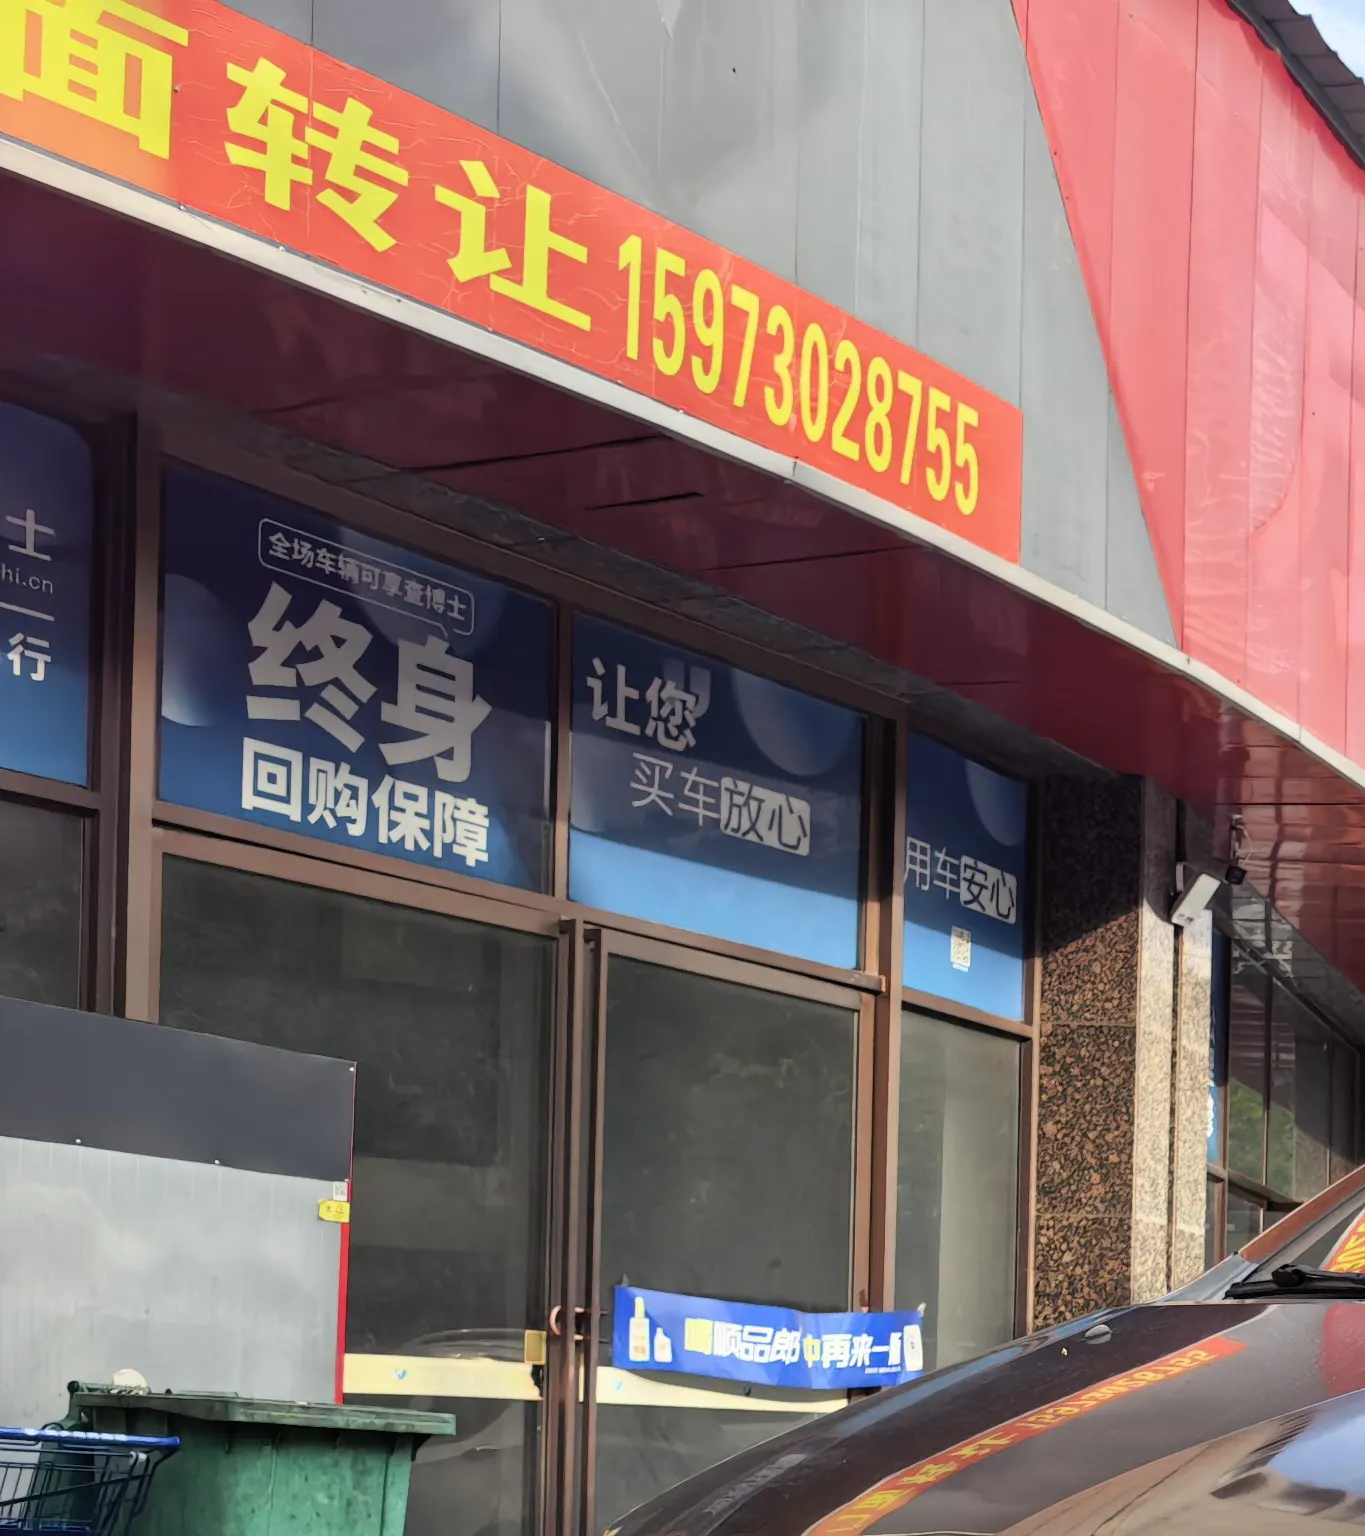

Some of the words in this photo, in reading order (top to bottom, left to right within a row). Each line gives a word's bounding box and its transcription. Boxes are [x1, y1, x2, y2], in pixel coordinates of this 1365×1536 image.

[617, 234, 980, 517] 15973028755
[7, 632, 52, 682] 行
[246, 581, 493, 783] 终身
[586, 657, 698, 752] 让您
[241, 737, 490, 868] 回购保障
[629, 752, 809, 854] 买车放心
[903, 835, 1016, 921] 用车安心
